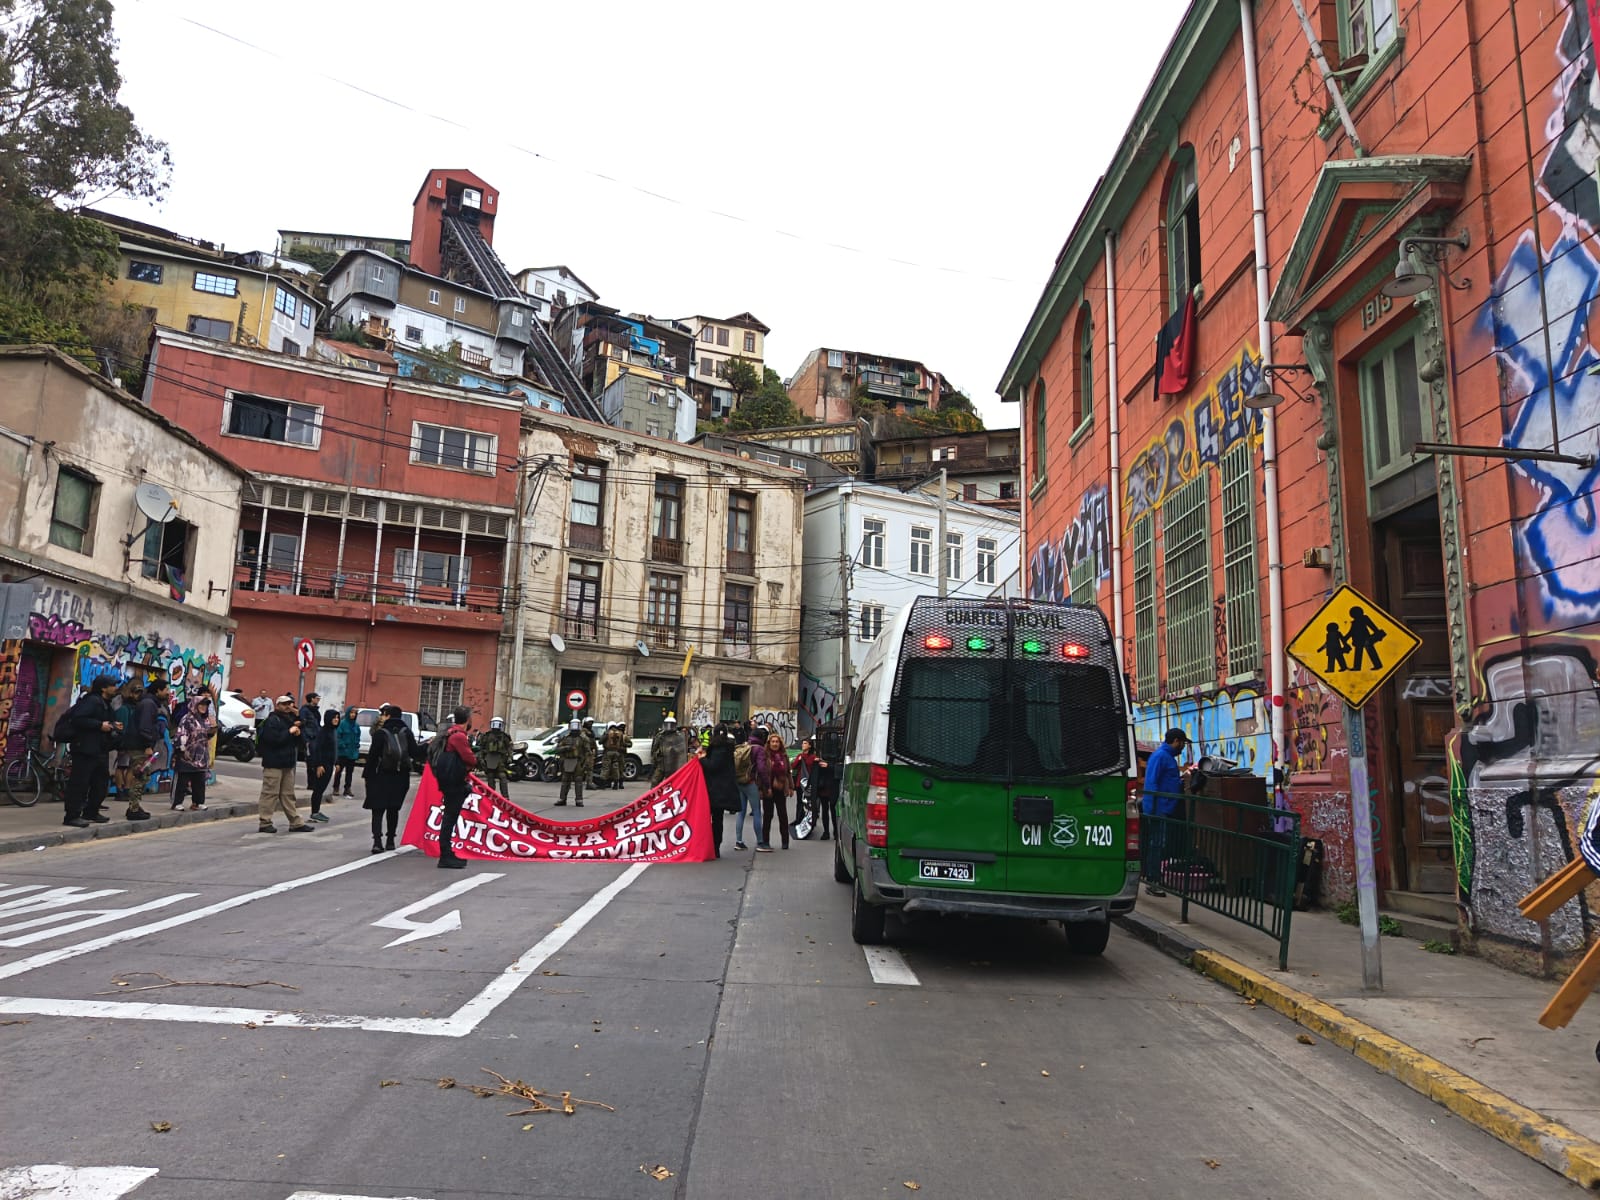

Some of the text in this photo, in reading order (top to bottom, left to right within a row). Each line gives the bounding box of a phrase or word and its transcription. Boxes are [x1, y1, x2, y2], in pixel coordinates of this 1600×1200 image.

[945, 610, 1004, 626] CUARTEL
[487, 805, 607, 847] LUCHA
[1021, 824, 1113, 846] CM 7420
[923, 866, 970, 879] CM 7420
